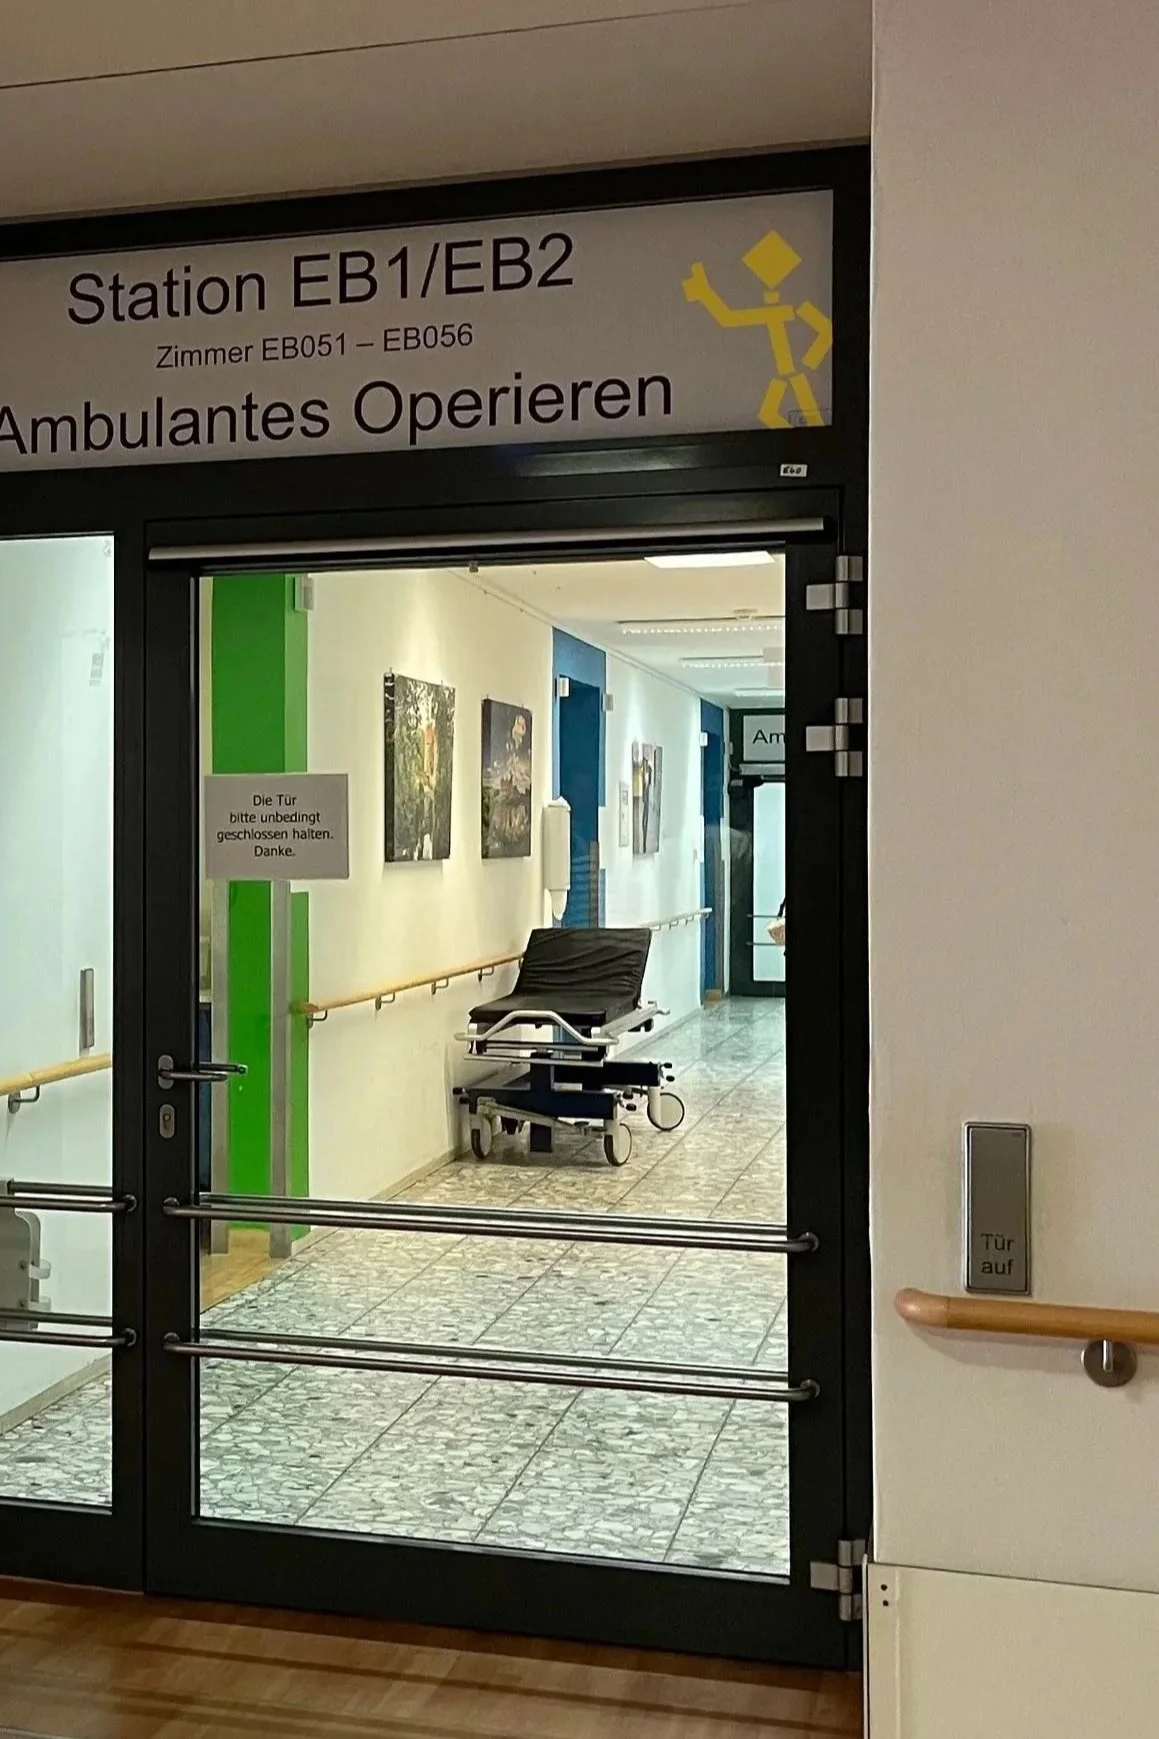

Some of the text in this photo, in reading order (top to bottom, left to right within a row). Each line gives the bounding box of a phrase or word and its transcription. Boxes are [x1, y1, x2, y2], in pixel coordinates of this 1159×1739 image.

[67, 232, 574, 326] Station EB1/EB2
[155, 344, 255, 370] Zimmer
[261, 332, 347, 361] EB051
[382, 322, 474, 352] EB056
[353, 371, 672, 448] Operieren
[752, 728, 785, 744] Am
[252, 793, 298, 807] Die Tür
[229, 810, 321, 826] bitte unbedingt
[216, 827, 334, 843] geschlossen halten.
[253, 844, 296, 858] Danke.
[980, 1232, 1015, 1252] Tür
[980, 1258, 1015, 1276] auf
